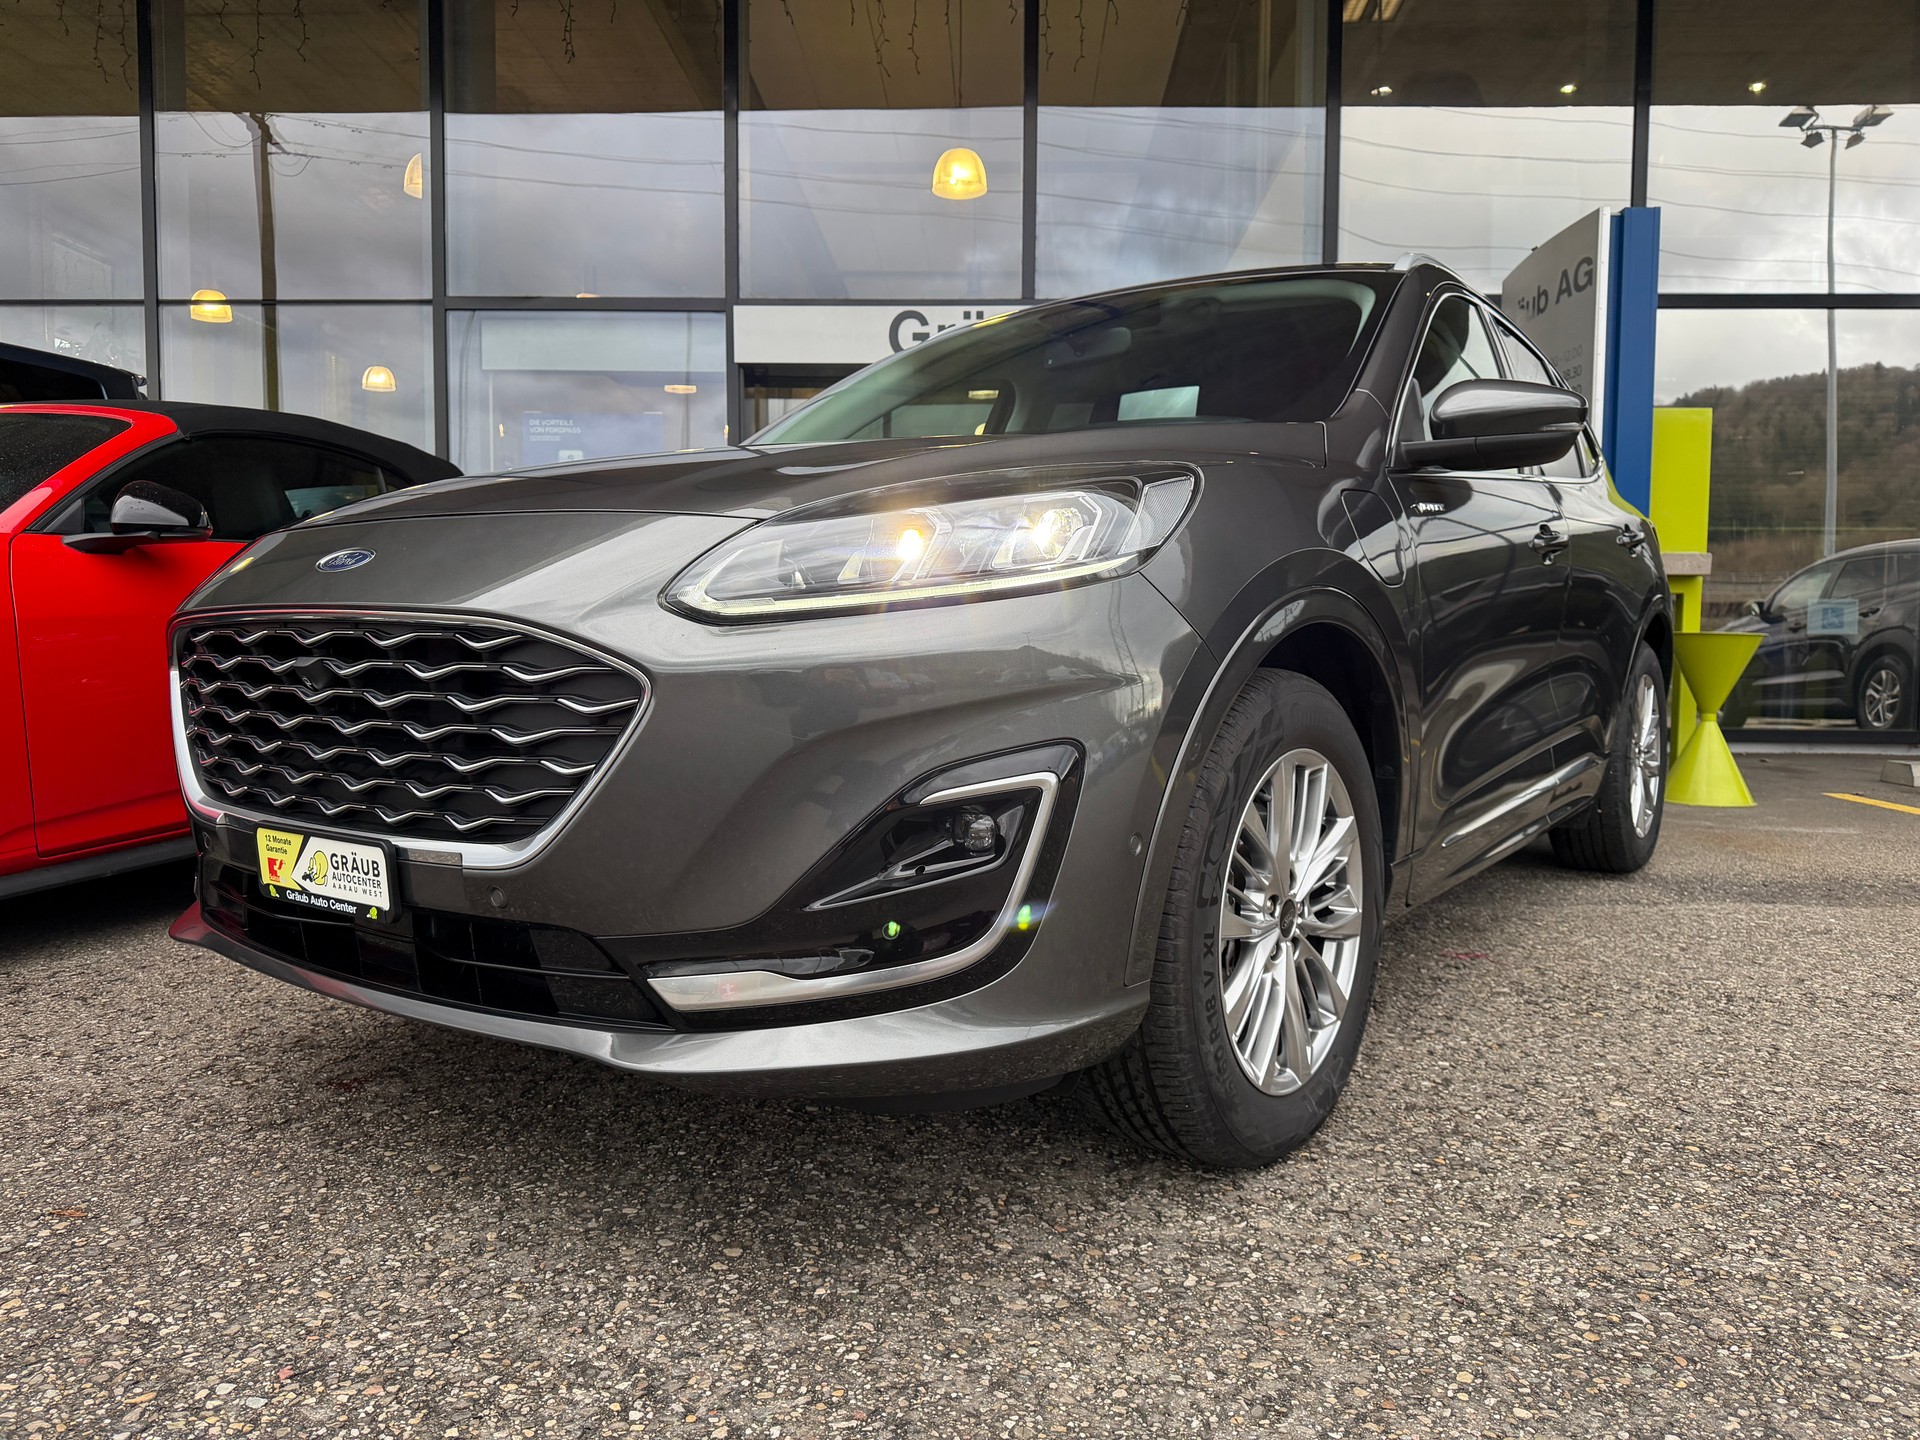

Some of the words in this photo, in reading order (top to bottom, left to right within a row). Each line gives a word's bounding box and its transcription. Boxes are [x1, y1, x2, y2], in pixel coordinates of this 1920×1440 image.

[1555, 256, 1594, 305] AG
[529, 426, 544, 434] VON
[265, 834, 272, 842] 12
[272, 836, 292, 846] Monate
[265, 844, 288, 855] Garantie
[330, 851, 381, 878] GRÄUB
[332, 871, 382, 890] AUTOCENTER
[332, 882, 358, 894] AARAU
[361, 887, 383, 898] WEST
[286, 890, 310, 904] Gräub
[310, 895, 329, 908] Auto
[329, 899, 357, 914] Center
[1203, 925, 1216, 958] XL
[1203, 970, 1215, 989] V
